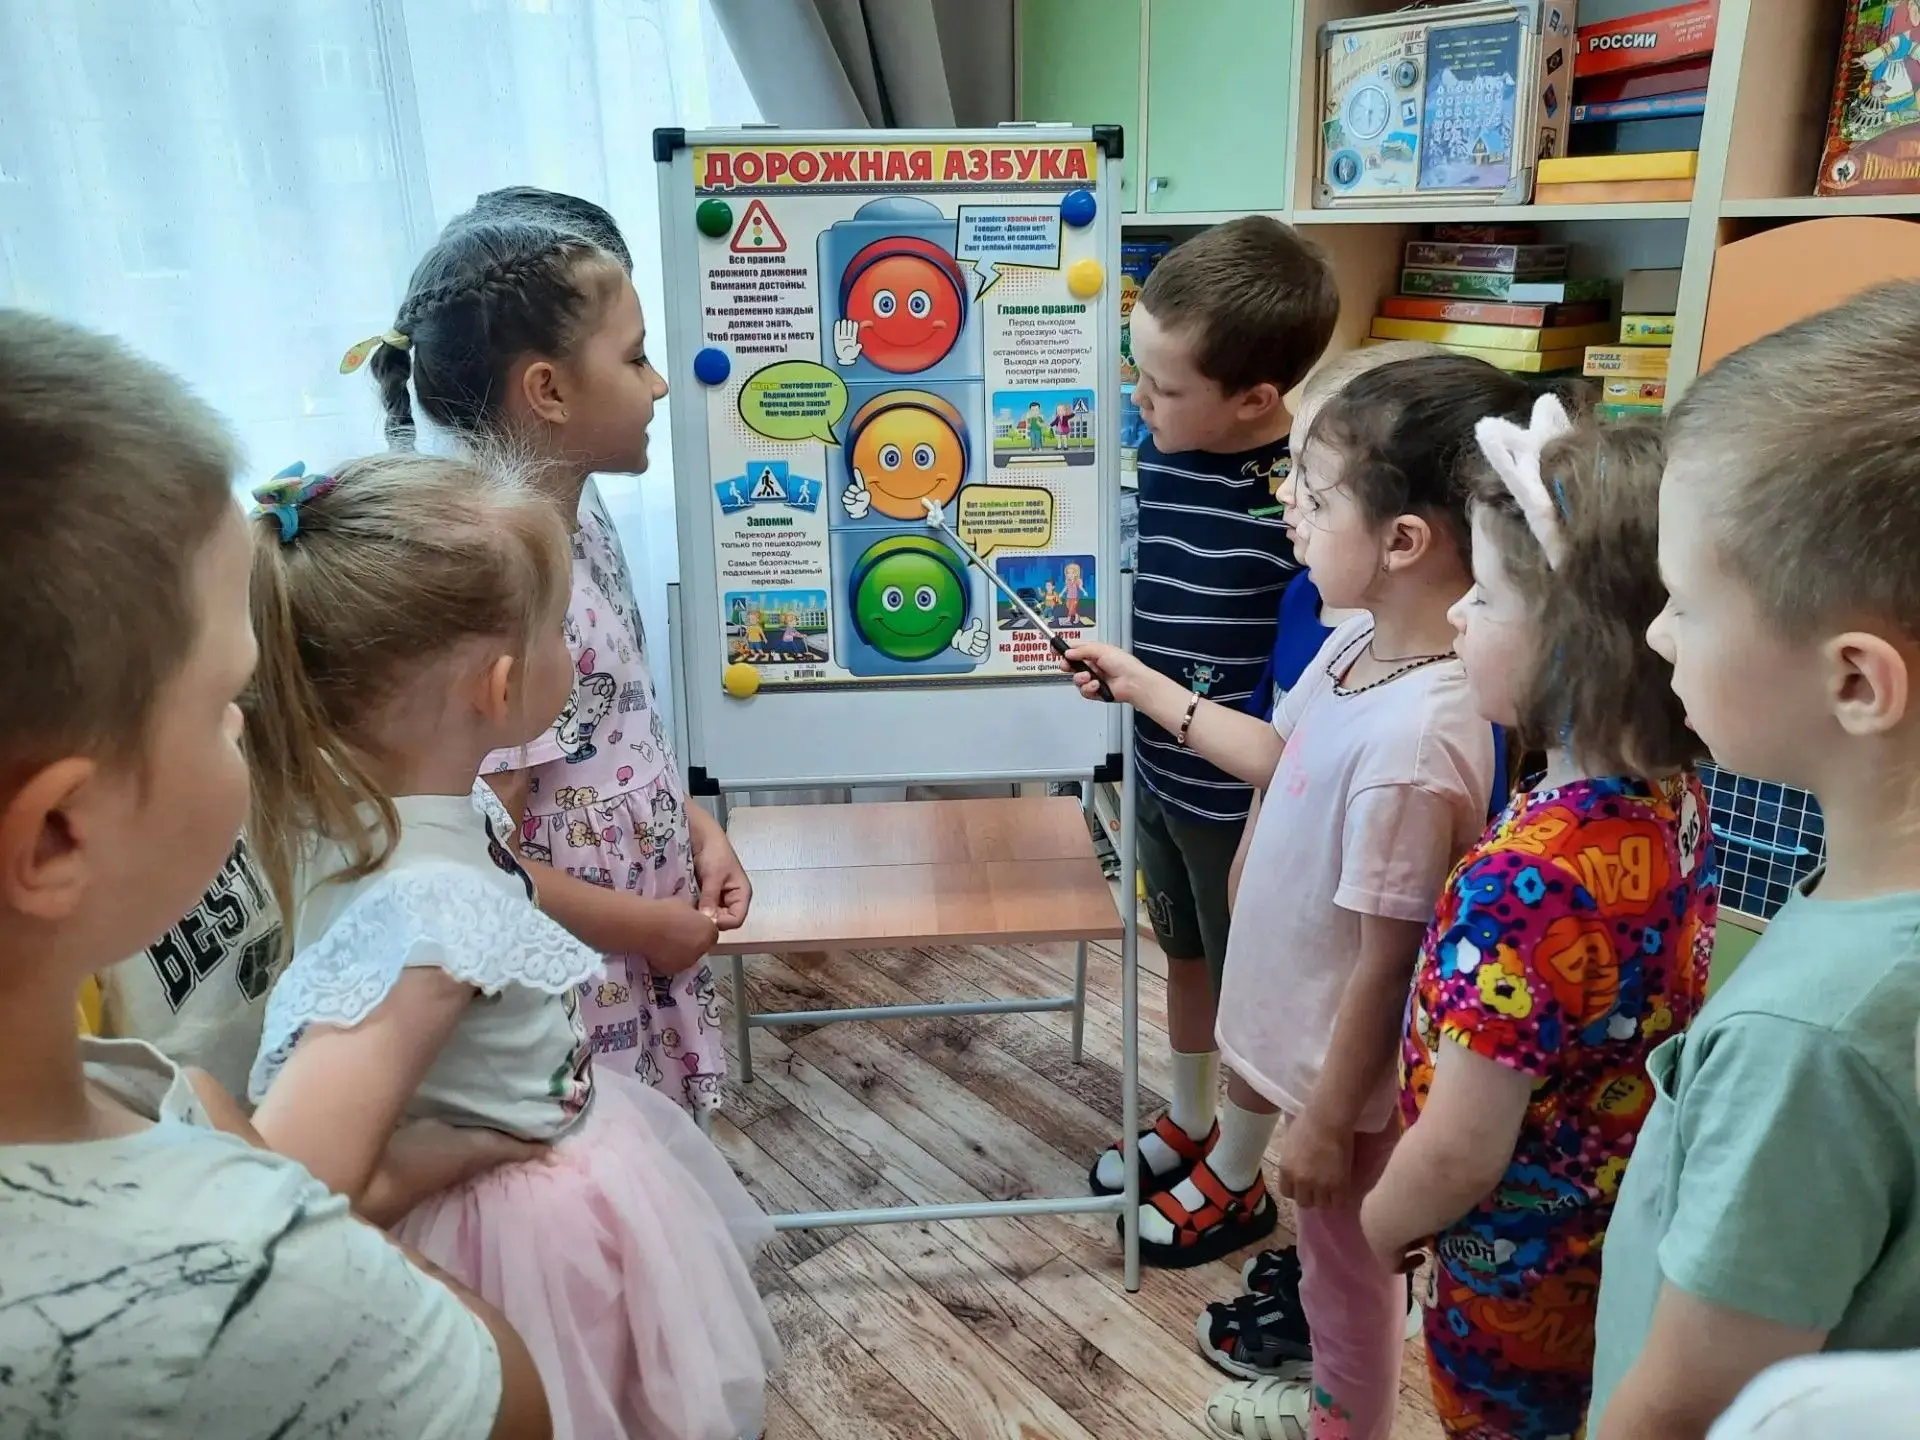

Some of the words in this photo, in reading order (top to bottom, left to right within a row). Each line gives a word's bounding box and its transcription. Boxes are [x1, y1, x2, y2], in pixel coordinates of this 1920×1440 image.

[1590, 33, 1657, 51] РОССИИ
[705, 151, 932, 188] ДОРОЖНАЯ
[944, 149, 1087, 181] АЗБУКА
[729, 255, 745, 265] Все
[747, 255, 786, 264] правила
[708, 269, 759, 278] дорожного
[760, 268, 807, 278] движения
[710, 281, 757, 290] Внимания
[733, 294, 779, 304] уважения
[706, 307, 717, 316] Их
[718, 307, 774, 316] непременно
[775, 304, 814, 315] каждый
[997, 304, 1040, 315] Главное
[1041, 303, 1087, 315] правило
[728, 320, 764, 329] должен
[1009, 318, 1035, 327] Перед
[1037, 318, 1076, 327] выходом
[707, 332, 729, 341] Чтоб
[730, 332, 772, 342] грамотно
[788, 331, 815, 341] месту
[1015, 328, 1056, 338] проезжую
[1016, 338, 1070, 346] обязательно
[735, 344, 788, 354] применять!
[993, 348, 1039, 356] остановись
[1047, 346, 1093, 356] осмотрись!
[1588, 353, 1621, 361] PUZZLE
[1004, 358, 1037, 367] Выходя
[1005, 368, 1046, 376] посмотри
[1015, 377, 1039, 385] затем
[746, 516, 793, 527] Запомни
[734, 531, 776, 540] Переходи
[778, 531, 807, 540] дорогу
[764, 540, 822, 549] пешеходному
[727, 559, 757, 568] Самые
[759, 559, 809, 567] безопасные
[723, 569, 771, 577] подземный
[1012, 631, 1037, 642] Будь
[1039, 630, 1081, 641] зетен
[1000, 643, 1011, 652] на
[1013, 642, 1048, 653] дороге
[1013, 654, 1044, 663] время
[1046, 653, 1065, 663] сут
[144, 838, 270, 1015] BEST
